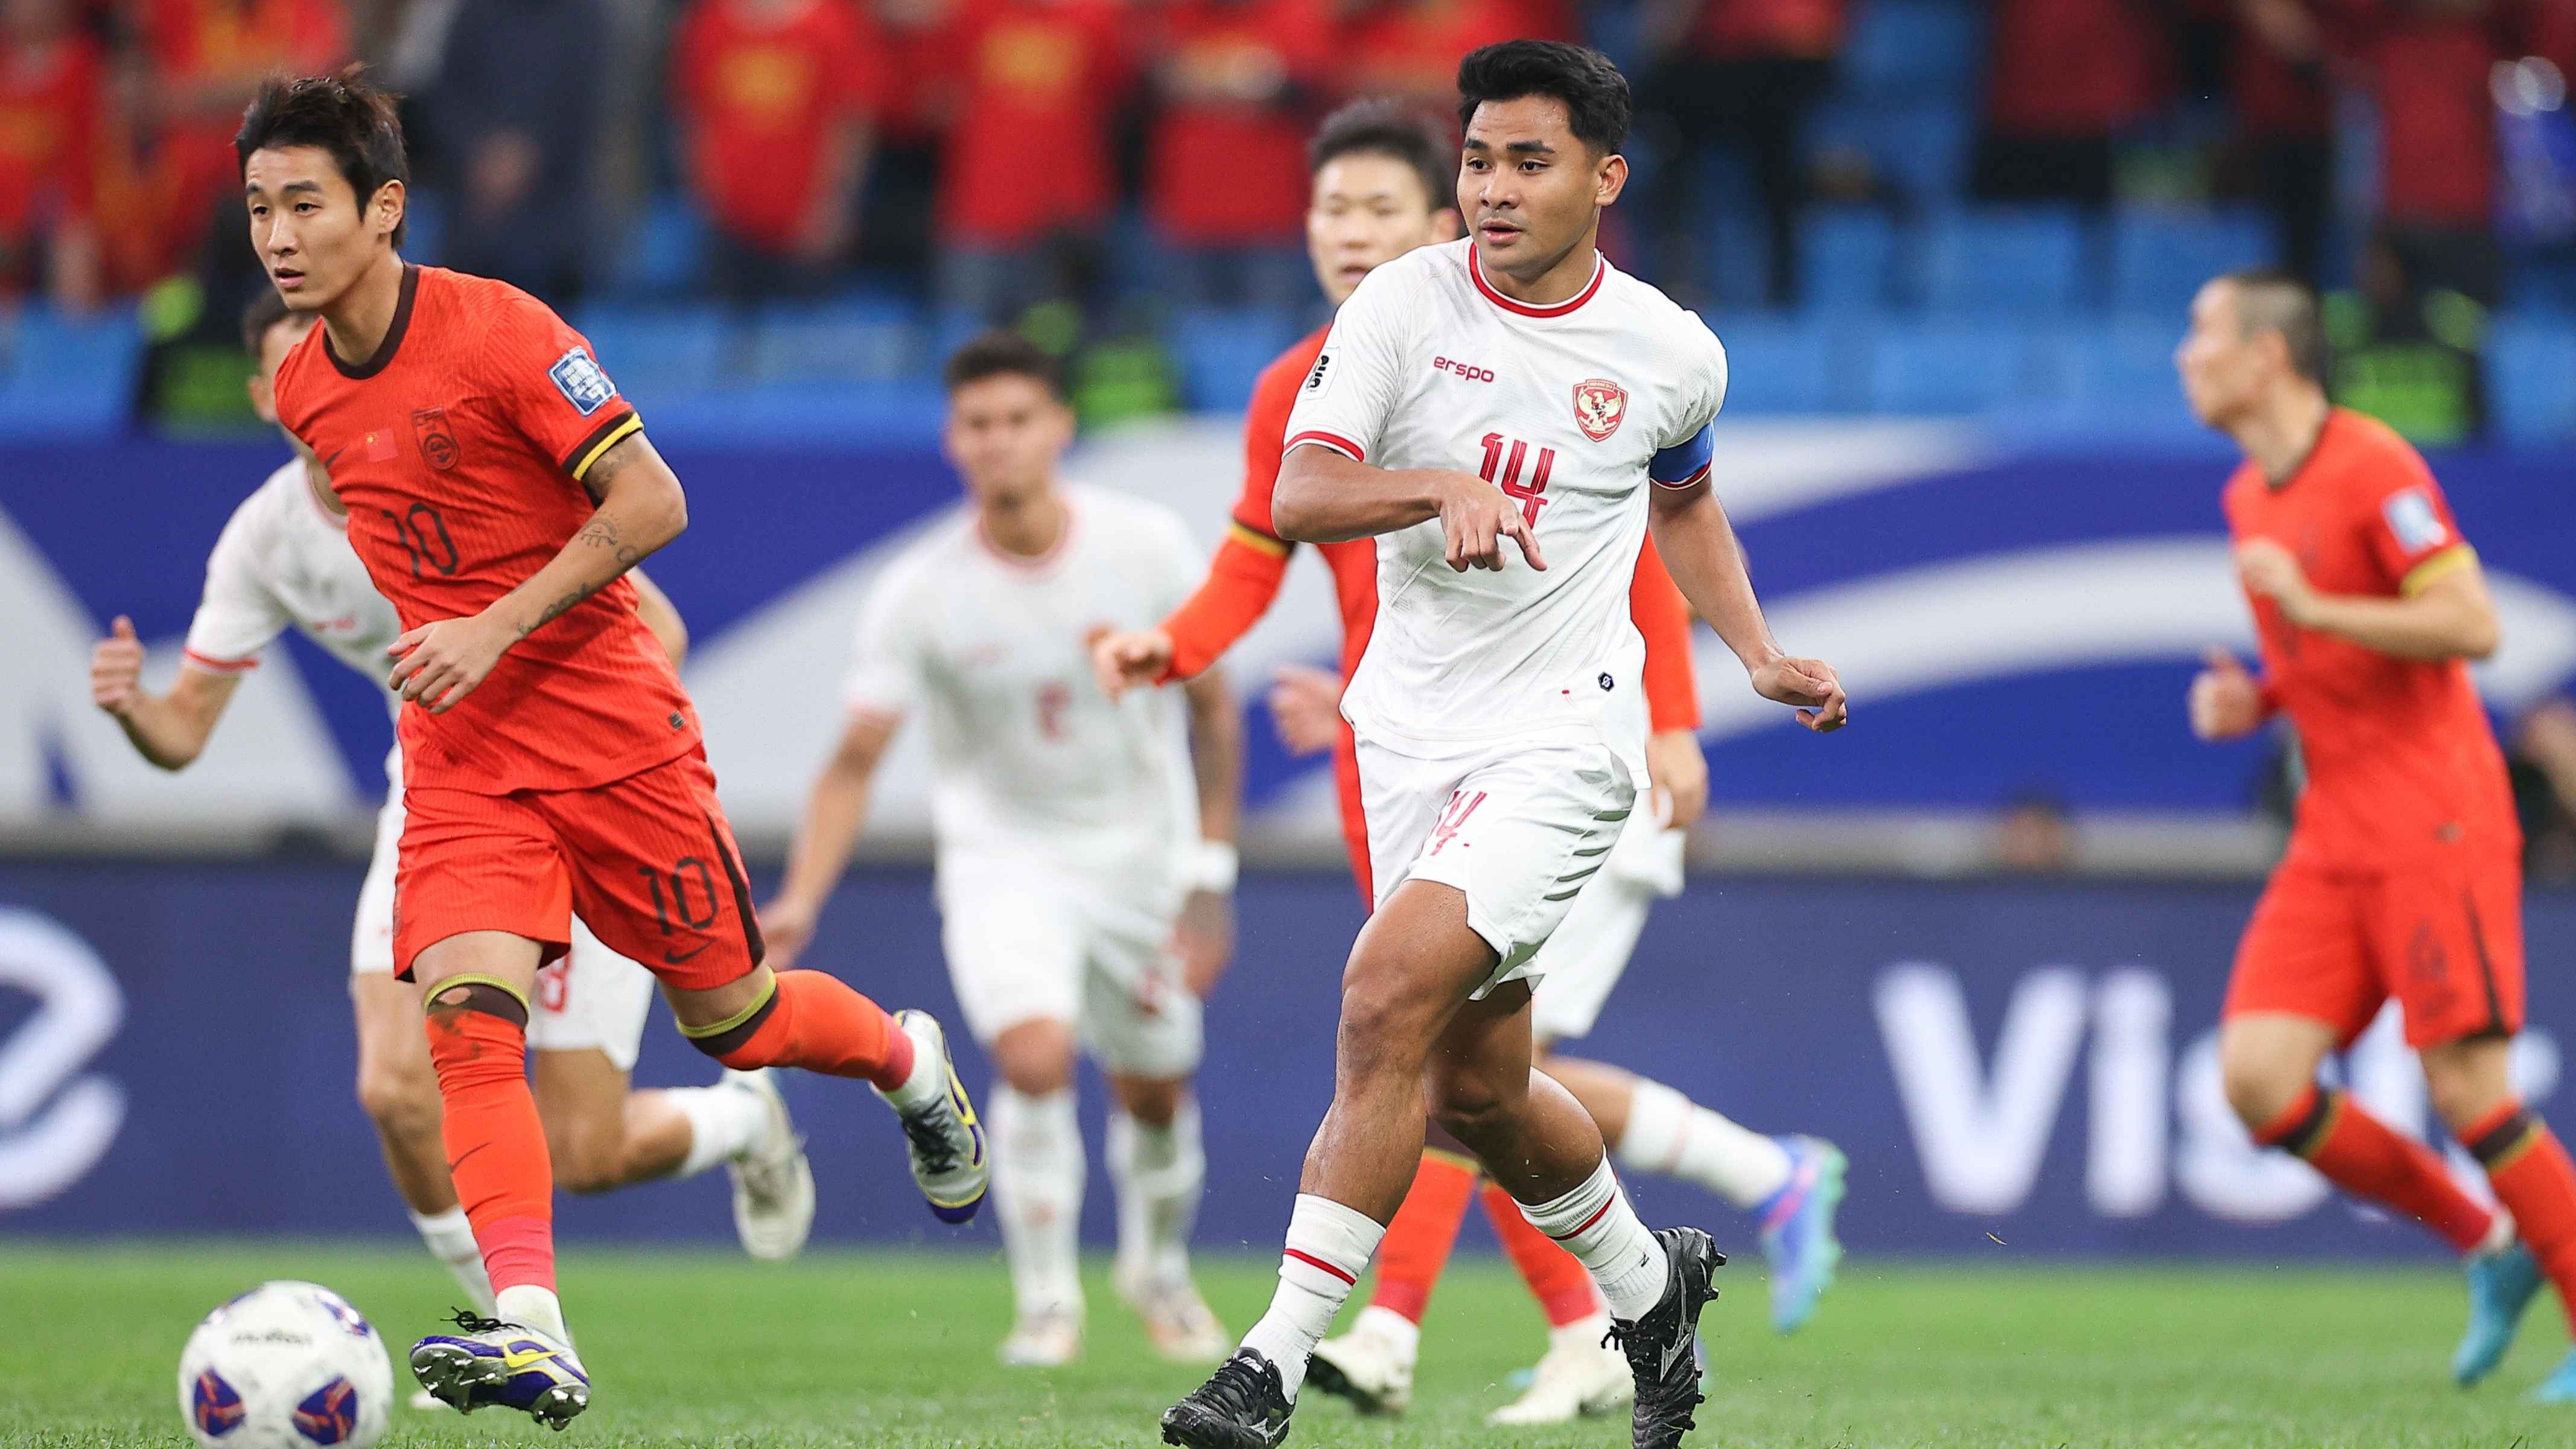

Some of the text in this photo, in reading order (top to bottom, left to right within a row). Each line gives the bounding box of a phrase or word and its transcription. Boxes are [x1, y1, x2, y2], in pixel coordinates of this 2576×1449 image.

[1434, 356, 1495, 383] erspo
[1480, 432, 1555, 530] 14
[381, 503, 459, 578] 10
[637, 856, 718, 936] 10
